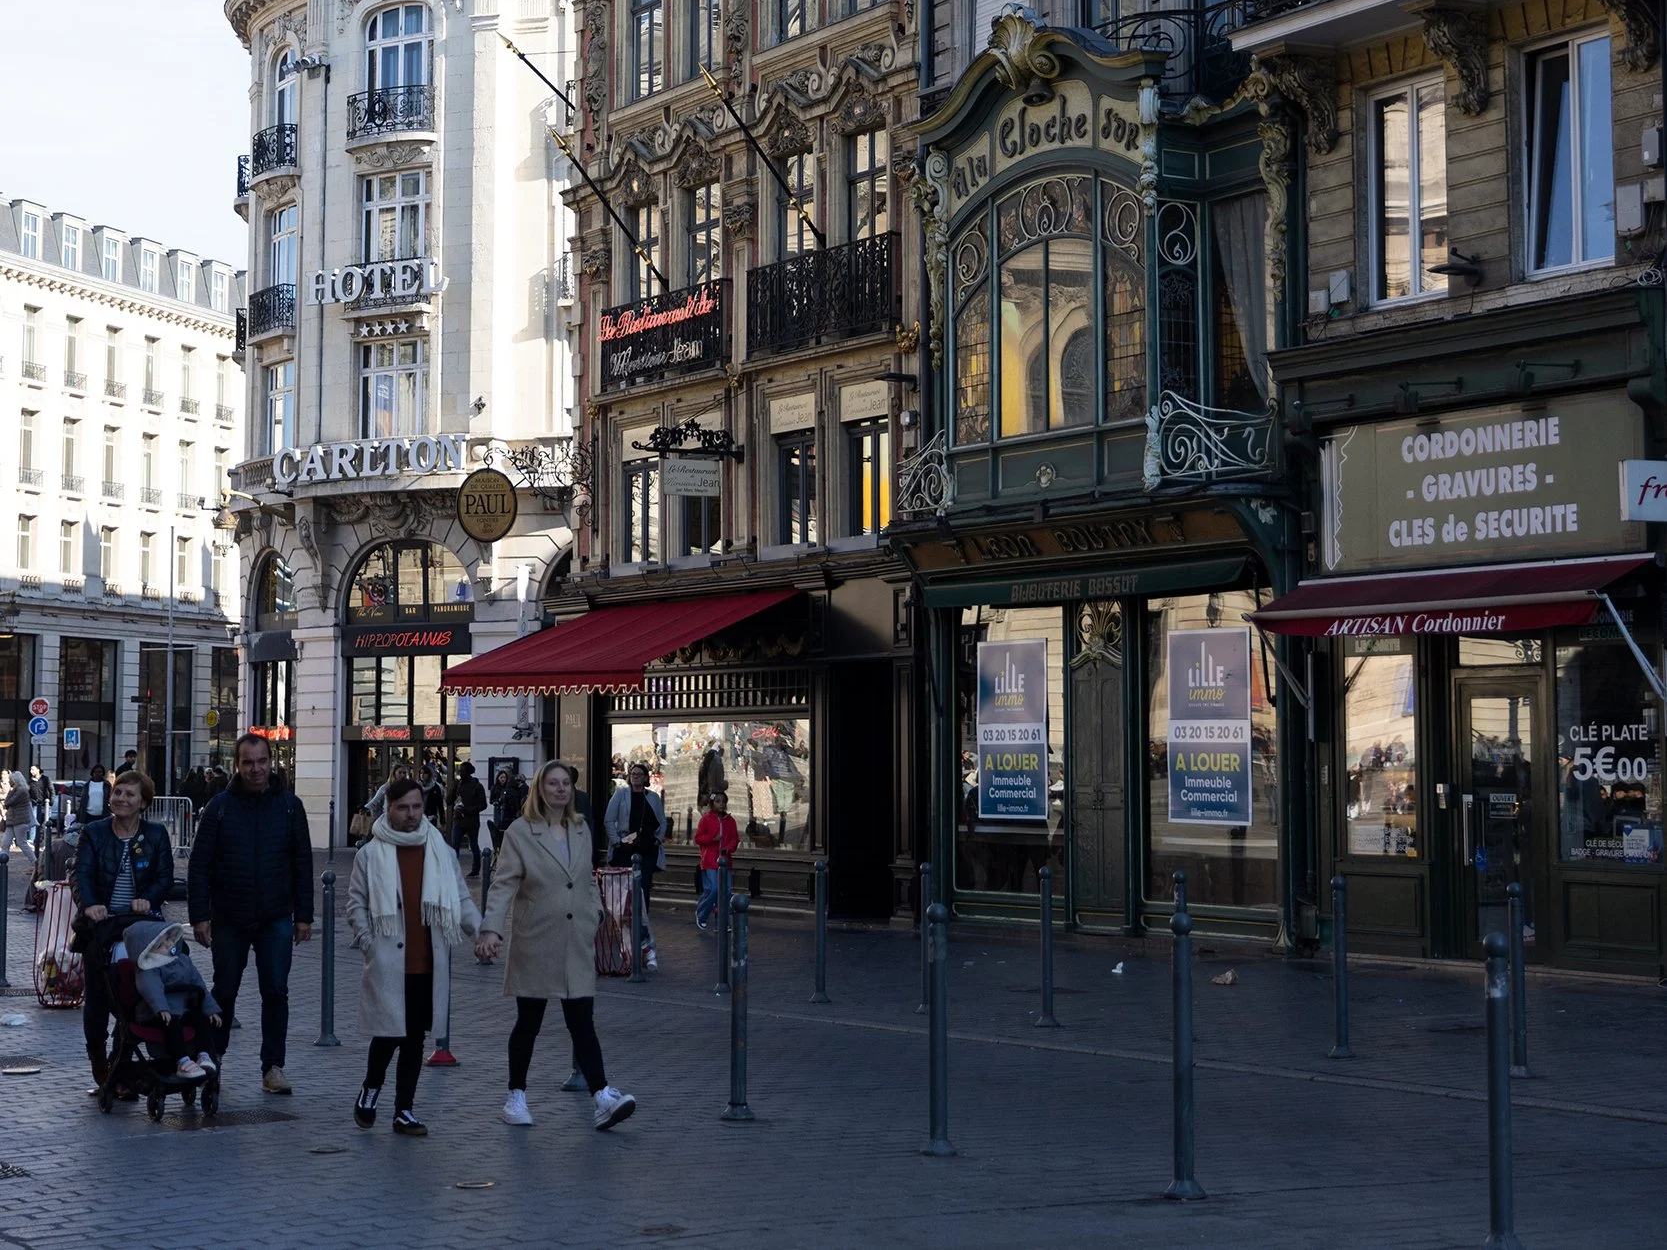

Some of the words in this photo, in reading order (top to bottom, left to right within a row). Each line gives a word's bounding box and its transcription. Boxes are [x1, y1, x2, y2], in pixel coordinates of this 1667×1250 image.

[967, 154, 989, 188] la
[1000, 94, 1088, 159] Cloche
[305, 257, 449, 306] HOTEL
[669, 337, 704, 364] Jean
[868, 397, 886, 411] Jean
[796, 412, 814, 425] Jean
[1401, 416, 1560, 463] CORDONNERIE
[273, 433, 470, 484] CARLTON
[697, 478, 720, 488] Jean
[1422, 462, 1538, 502] GRAVURES
[464, 494, 511, 515] PAUL
[1389, 517, 1435, 548] CLES
[1441, 514, 1468, 543] de
[1474, 503, 1578, 540] SECURITE
[1011, 579, 1081, 602] BIJOUTERIE
[1088, 574, 1139, 595] BOSSUT
[434, 605, 470, 613] PANORAMIQUE
[1323, 615, 1409, 636] ARTISAN
[1411, 610, 1506, 633] Cordonnier
[355, 631, 452, 648] HIPPOPOTAMUS
[994, 694, 1025, 707] immo
[1189, 688, 1225, 701] immo
[424, 726, 444, 739] Grill
[983, 730, 993, 741] 03
[995, 729, 1006, 741] 20
[1008, 729, 1017, 741] 15
[1018, 729, 1029, 740] 20
[1031, 728, 1041, 740] 61
[1174, 726, 1187, 739] 03
[1189, 726, 1201, 739] 20
[1204, 726, 1215, 739] 15
[1217, 726, 1230, 739] 20
[1232, 726, 1243, 739] 61
[1569, 721, 1598, 741] CLÉ
[1601, 724, 1649, 741] PLATE
[985, 754, 994, 770] A
[997, 753, 1039, 770] LOUER
[1175, 753, 1186, 771] A
[1190, 752, 1240, 772] LOUER
[992, 774, 1031, 786] Immeuble
[1185, 775, 1232, 788] Immeuble
[988, 787, 1036, 798] Commercial
[1180, 789, 1238, 803] Commercial
[997, 802, 1029, 813] lille-immo.fr
[1190, 808, 1229, 818] lille-immo.fr
[1598, 840, 1607, 848] DE
[1571, 848, 1591, 856] BADGE
[1595, 849, 1624, 858] GRAVURE
